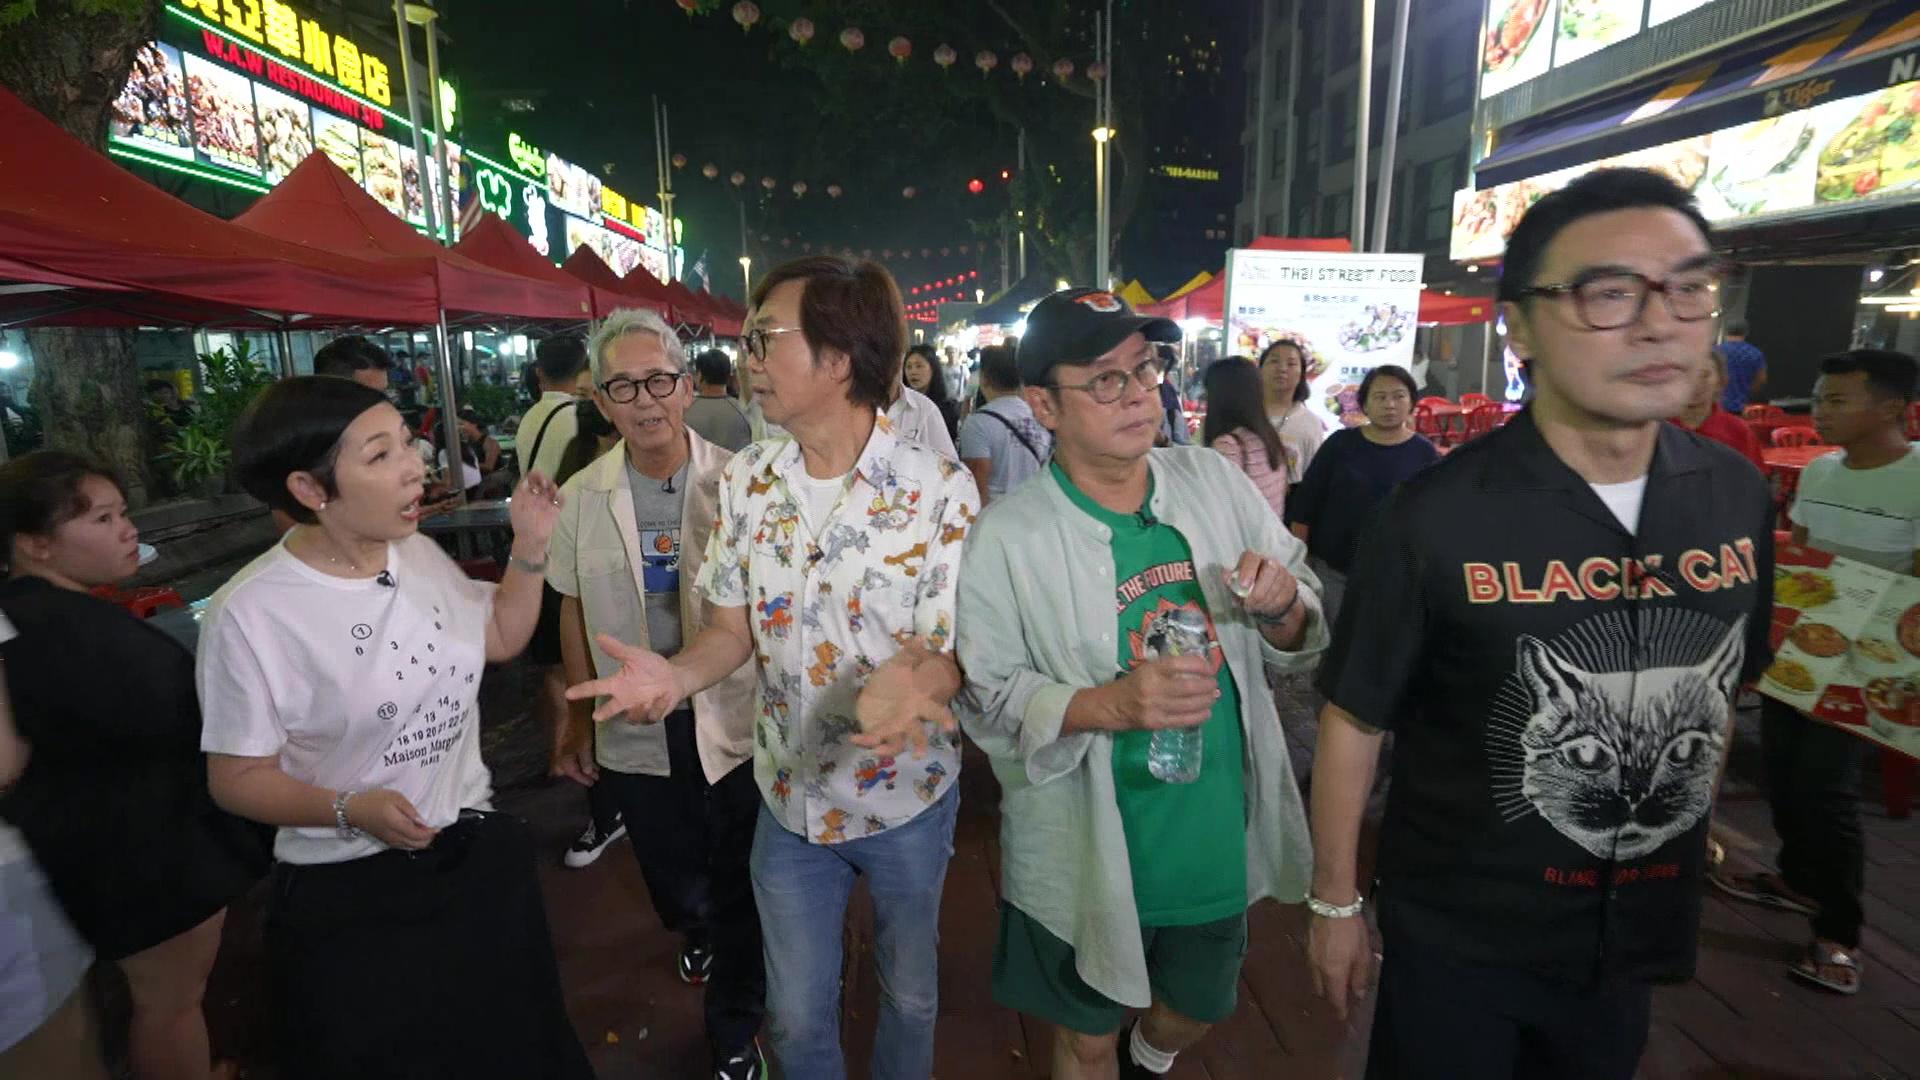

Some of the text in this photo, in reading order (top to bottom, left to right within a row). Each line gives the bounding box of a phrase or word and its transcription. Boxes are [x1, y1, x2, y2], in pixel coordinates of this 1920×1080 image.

[266, 59, 361, 120] RESTAURANT
[1318, 268, 1375, 282] STREET
[1118, 575, 1146, 602] THE
[1145, 560, 1193, 588] FUTURE
[1463, 537, 1758, 604] BLACK CAT
[390, 640, 399, 651] 3
[396, 670, 404, 681] 2
[384, 746, 428, 767] Maison
